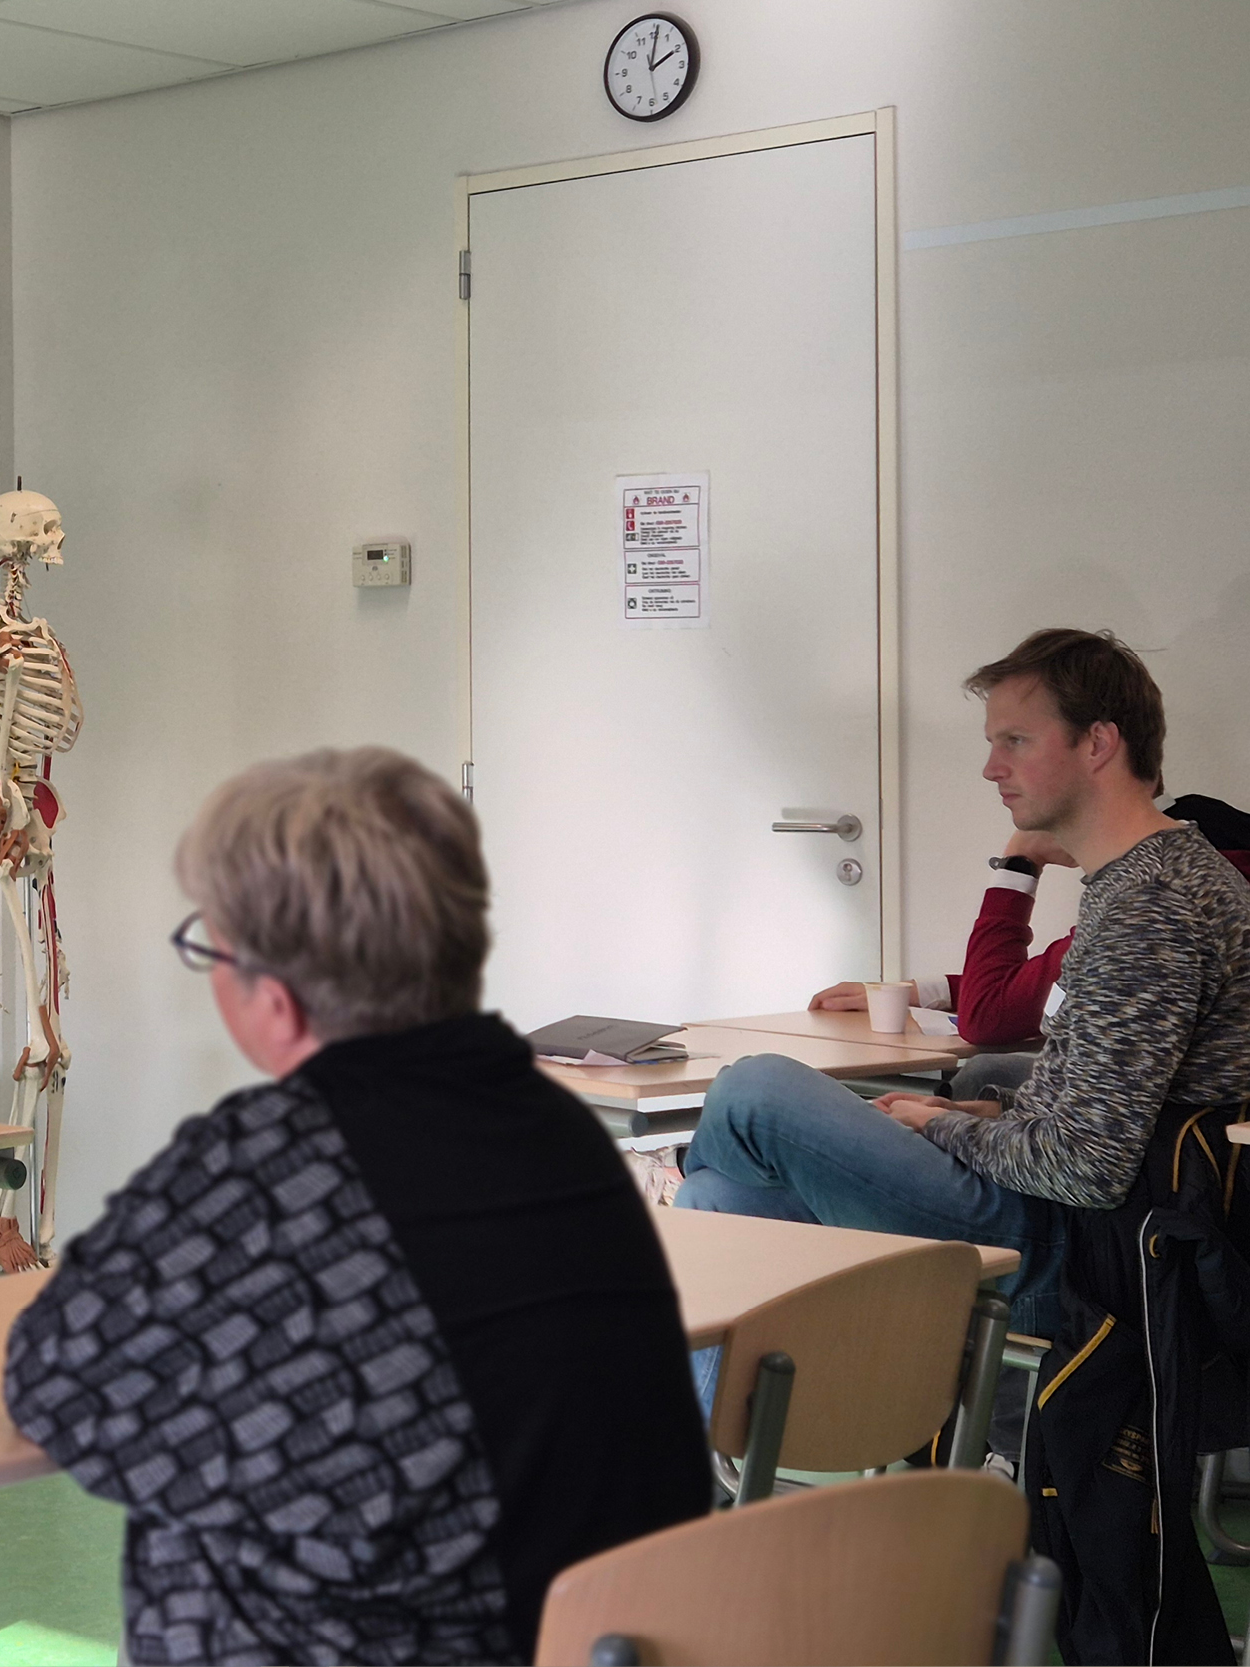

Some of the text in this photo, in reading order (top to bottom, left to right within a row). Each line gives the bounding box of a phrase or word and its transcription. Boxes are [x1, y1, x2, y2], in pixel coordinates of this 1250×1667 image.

[636, 37, 646, 46] 11
[665, 33, 670, 42] 1
[674, 44, 681, 53] 2
[627, 50, 637, 60] 10
[679, 60, 685, 69] 3
[621, 68, 628, 77] 9
[673, 78, 680, 86] 4
[625, 84, 632, 93] 8
[636, 95, 642, 105] 7
[662, 92, 669, 101] 5
[648, 98, 655, 107] 6
[646, 495, 675, 505] BRAND
